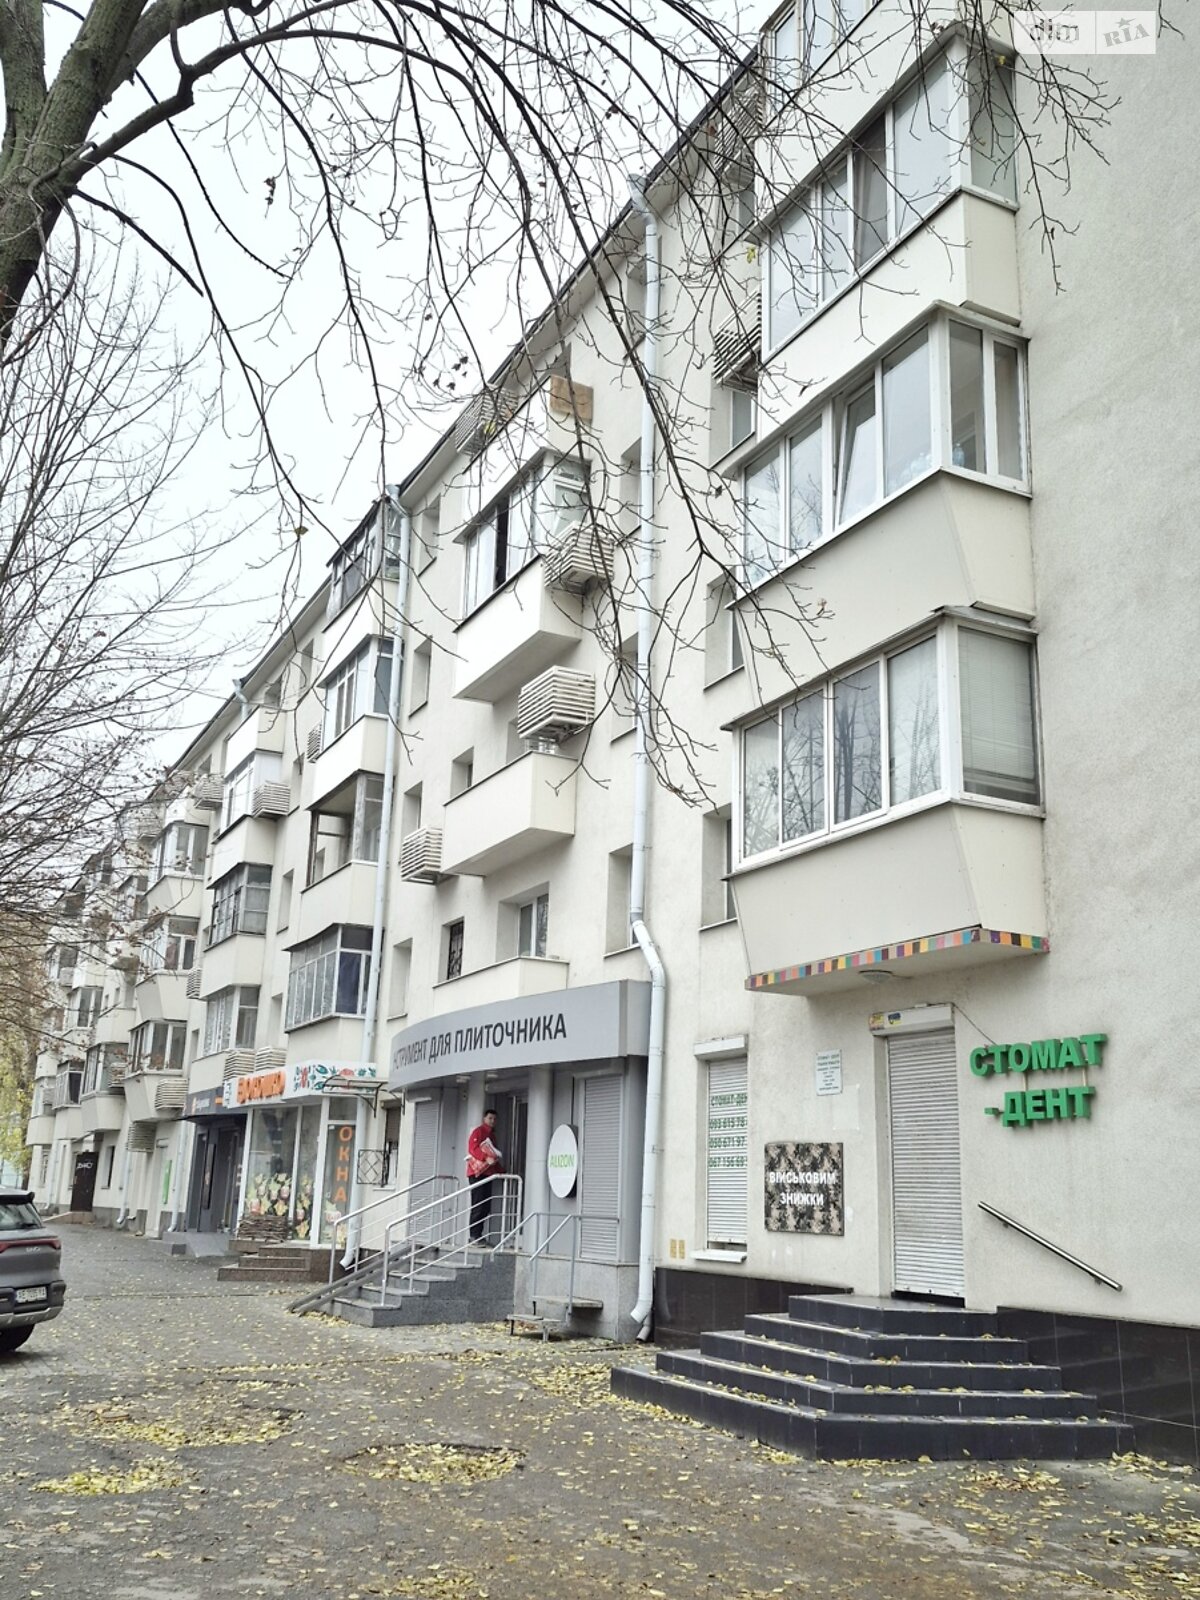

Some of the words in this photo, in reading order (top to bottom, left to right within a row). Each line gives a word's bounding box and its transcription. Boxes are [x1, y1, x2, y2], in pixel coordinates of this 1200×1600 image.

[429, 1032, 450, 1064] ДЛЯ
[454, 1013, 567, 1052] ПЛИТОЧНИКА
[970, 1033, 1108, 1077] СТОМАТ
[335, 1126, 353, 1202] ОКНА
[780, 1192, 824, 1205] ЗНИЖКИ
